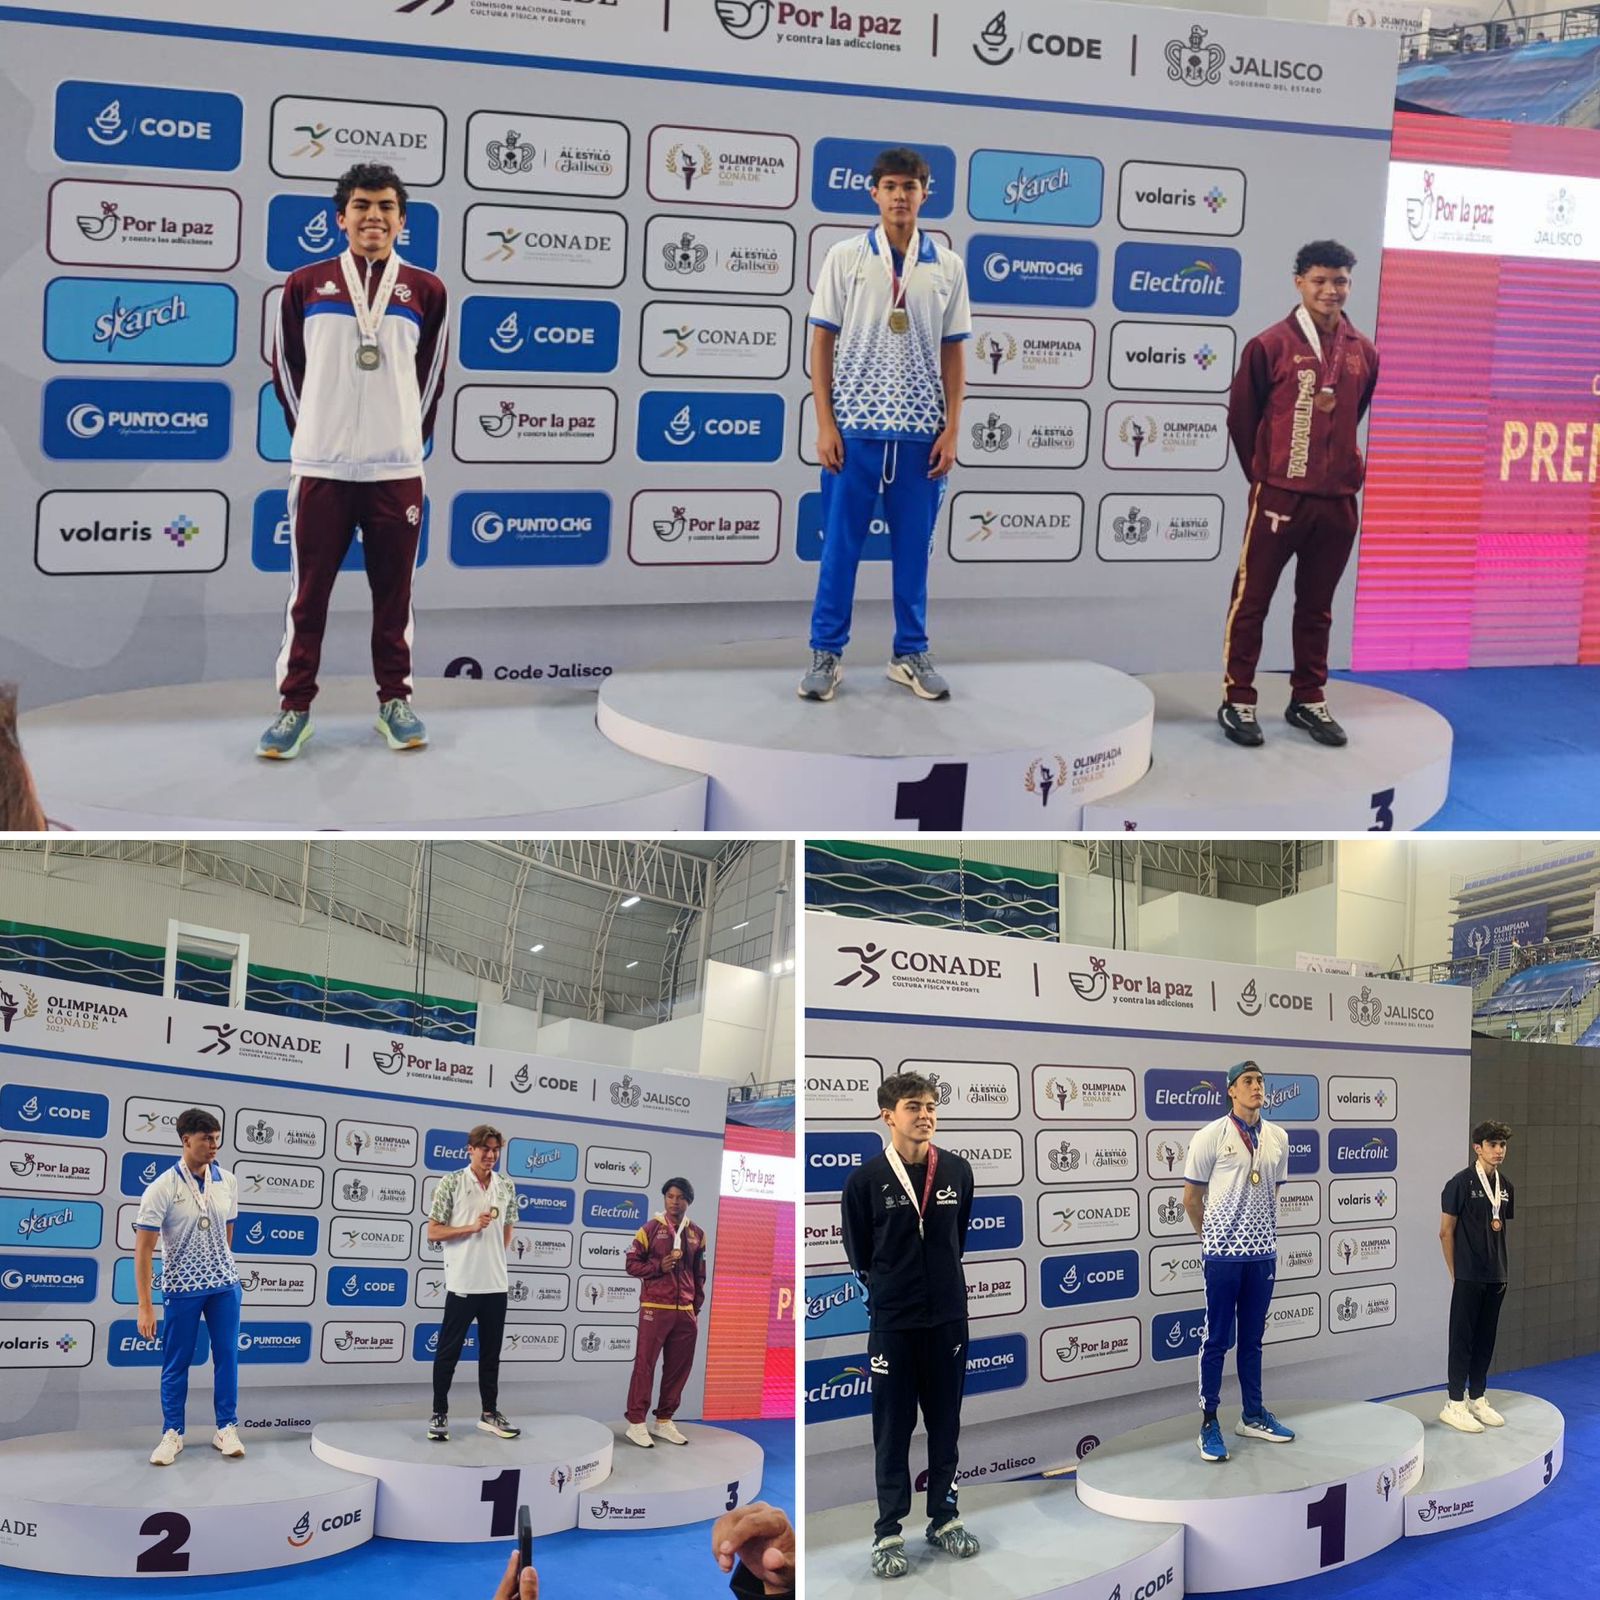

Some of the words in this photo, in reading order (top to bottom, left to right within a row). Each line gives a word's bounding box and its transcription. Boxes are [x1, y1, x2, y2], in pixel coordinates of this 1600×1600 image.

[471, 1, 512, 9] COMISIÓN
[515, 4, 557, 14] NACIONAL
[471, 9, 508, 18] CULTURA
[548, 16, 585, 25] DEPORTE
[778, 2, 823, 27] Por
[831, 7, 851, 30] la
[859, 14, 901, 37] paz
[777, 34, 782, 43] y
[786, 33, 823, 45] contra
[826, 34, 841, 46] las
[844, 38, 901, 52] adicciones
[1027, 33, 1102, 59] CODE
[1230, 56, 1323, 81] JALISCO
[1291, 86, 1322, 94] ESTADO
[140, 118, 211, 140] CODE
[335, 128, 427, 149] CONADE
[560, 150, 573, 159] AL
[576, 152, 611, 161] ESTILO
[720, 154, 784, 168] OLIMPIADA
[561, 160, 610, 173] Jalisco
[1136, 187, 1196, 206] volaris
[1435, 195, 1457, 221] Por
[1460, 197, 1470, 222] la
[1473, 204, 1494, 229] paz
[123, 217, 156, 232] Por
[162, 218, 176, 233] la
[182, 223, 213, 237] paz
[525, 233, 611, 251] CONADE
[1534, 231, 1582, 246] JALISCO
[731, 251, 743, 259] AL
[745, 251, 777, 260] ESTILO
[1013, 260, 1055, 274] PUNTO
[1057, 263, 1083, 275] CHG
[1129, 271, 1224, 295] Electrolit
[534, 327, 595, 344] CODE
[698, 330, 776, 346] CONADE
[1024, 340, 1081, 351] OLIMPIADA
[1126, 347, 1186, 364] volaris
[109, 412, 170, 427] PUNTO
[172, 413, 208, 427] CHG
[518, 414, 547, 428] Por
[551, 414, 564, 427] la
[568, 416, 595, 431] paz
[1287, 369, 1316, 478] TAMAULIPAS
[705, 420, 761, 435] CODE
[1164, 423, 1217, 432] OLIMPIADA
[507, 518, 558, 531] PUNTO
[561, 518, 592, 531] CHG
[689, 518, 715, 531] Por
[719, 518, 731, 530] la
[735, 520, 759, 533] paz
[1000, 515, 1070, 528] CONADE
[60, 521, 152, 542] volaris
[494, 665, 543, 680] Code
[548, 663, 612, 678] Jalisco
[1073, 747, 1121, 769] OLIMPIADA
[1368, 788, 1395, 831] 3
[1494, 921, 1529, 934] OLIMPIADA
[891, 951, 1001, 978] CONADE
[893, 975, 925, 983] COMISIÓN
[927, 978, 959, 986] NACIONAL
[1112, 974, 1142, 992] Por
[1147, 977, 1161, 994] la
[1165, 982, 1193, 999] paz
[48, 996, 128, 1018] OLIMPIADA
[1113, 995, 1117, 1003] y
[1119, 996, 1144, 1004] contra
[1157, 999, 1193, 1008] adicciones
[1269, 993, 1312, 1011] CODE
[47, 1008, 117, 1023] NACIONAL
[1384, 1006, 1434, 1021] JALISCO
[47, 1016, 98, 1030] CONADE
[240, 1030, 321, 1054] CONADE
[407, 1055, 432, 1070] Por
[436, 1058, 446, 1072] la
[450, 1064, 473, 1076] paz
[442, 1076, 473, 1084] adicciones
[539, 1076, 578, 1092] CODE
[805, 1078, 869, 1091] ONADE
[1082, 1083, 1126, 1091] OLIMPIADA
[643, 1092, 690, 1107] JALISCO
[971, 1094, 1006, 1103] Jalisco
[1156, 1089, 1221, 1105] Electrolit
[1337, 1092, 1371, 1103] volaris
[49, 1106, 90, 1120] CODE
[1297, 1145, 1311, 1153] CHG
[1338, 1146, 1388, 1160] Electrolit
[594, 1161, 625, 1171] volaris
[810, 1154, 862, 1168] CODE
[37, 1162, 56, 1172] Por
[60, 1164, 68, 1172] la
[72, 1166, 90, 1175] paz
[267, 1177, 315, 1188] CONADE
[1280, 1195, 1313, 1204] OLIMPIADA
[1338, 1194, 1371, 1205] volaris
[591, 1205, 640, 1219] Electrolit
[1077, 1207, 1130, 1220] CONADE
[967, 1217, 1005, 1230] ODE
[271, 1229, 304, 1240] CODE
[361, 1232, 404, 1242] CONADE
[589, 1246, 620, 1256] volaris
[25, 1274, 61, 1284] PUNTO
[63, 1275, 84, 1284] CHG
[261, 1277, 277, 1286] Por
[279, 1278, 287, 1286] la
[289, 1279, 304, 1288] paz
[1087, 1270, 1124, 1283] CODE
[364, 1282, 395, 1292] CODE
[1274, 1307, 1314, 1320] CONADE
[380, 1338, 393, 1346] paz
[522, 1336, 559, 1344] CONADE
[1081, 1342, 1098, 1352] Por
[1101, 1340, 1110, 1350] la
[1112, 1338, 1128, 1350] paz
[244, 1419, 271, 1428] Code
[274, 1418, 311, 1427] Jalisco
[1544, 1450, 1553, 1485] 3
[481, 1469, 520, 1537] 1
[725, 1481, 739, 1511] 3
[609, 1506, 623, 1516] Por
[625, 1506, 632, 1515] la
[633, 1508, 645, 1517] paz
[321, 1509, 362, 1532] CODE
[1307, 1483, 1347, 1568] 1
[137, 1511, 191, 1572] 2
[1135, 1567, 1174, 1600] CODE
